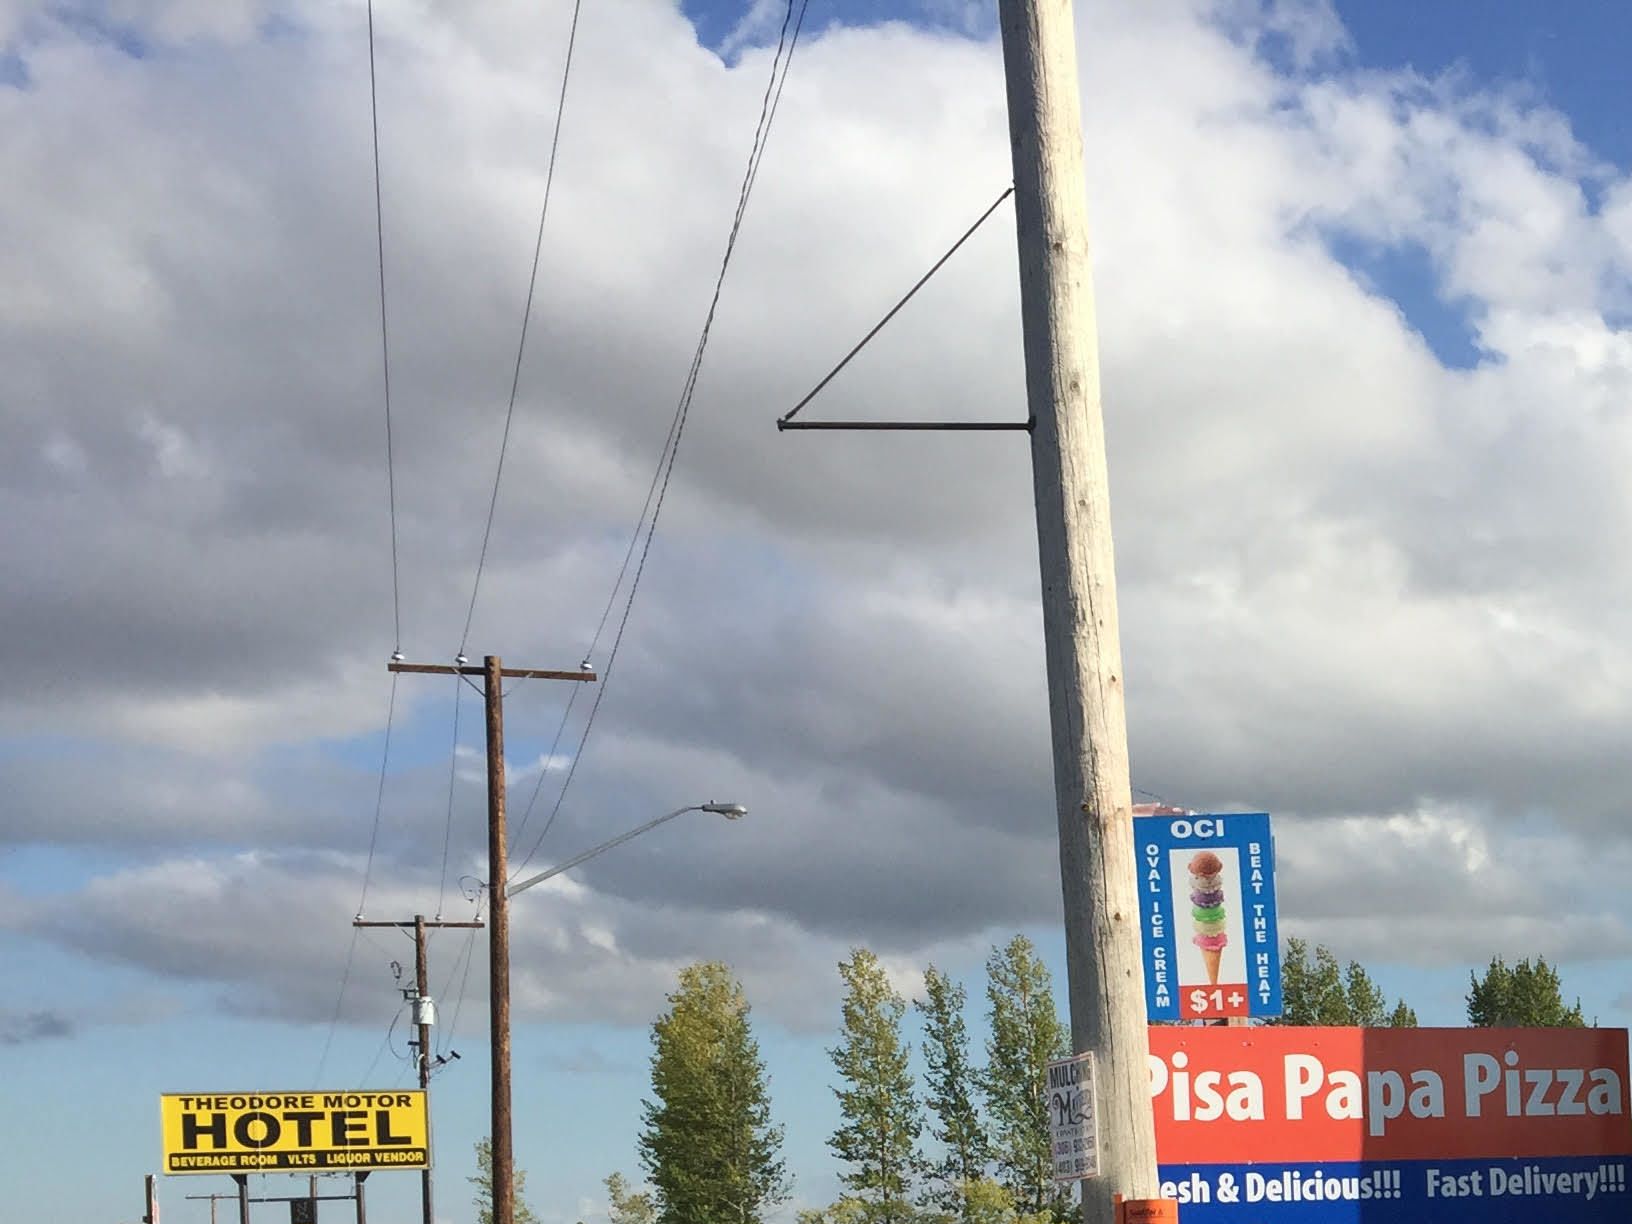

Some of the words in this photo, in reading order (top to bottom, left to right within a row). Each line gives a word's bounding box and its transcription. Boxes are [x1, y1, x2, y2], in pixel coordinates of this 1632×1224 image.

[1170, 819, 1225, 838] OCI
[1146, 844, 1161, 893] OVAL
[1249, 842, 1264, 895] BEAT
[1151, 902, 1165, 939] ICE
[1253, 904, 1267, 943] THE
[1153, 946, 1170, 1008] CREAM
[1256, 953, 1271, 1005] HEAT
[1190, 989, 1244, 1014] $1+
[179, 1096, 314, 1111] THEODORE
[323, 1094, 412, 1109] MOTOR
[1284, 1053, 1445, 1137] Papa
[1464, 1050, 1622, 1118] Pizza
[182, 1111, 412, 1150] HOTEL
[171, 1155, 239, 1168] BEVERAGE
[240, 1154, 278, 1165] ROOM
[287, 1153, 317, 1165] VLTS
[326, 1152, 371, 1164] LIQUOR
[374, 1151, 424, 1163] VENDOR
[1158, 1172, 1210, 1204] esh
[1217, 1172, 1240, 1203] &
[1246, 1169, 1401, 1202] Delicious!!!
[1426, 1168, 1484, 1199] Fast
[1489, 1163, 1626, 1201] Delivery!!!
